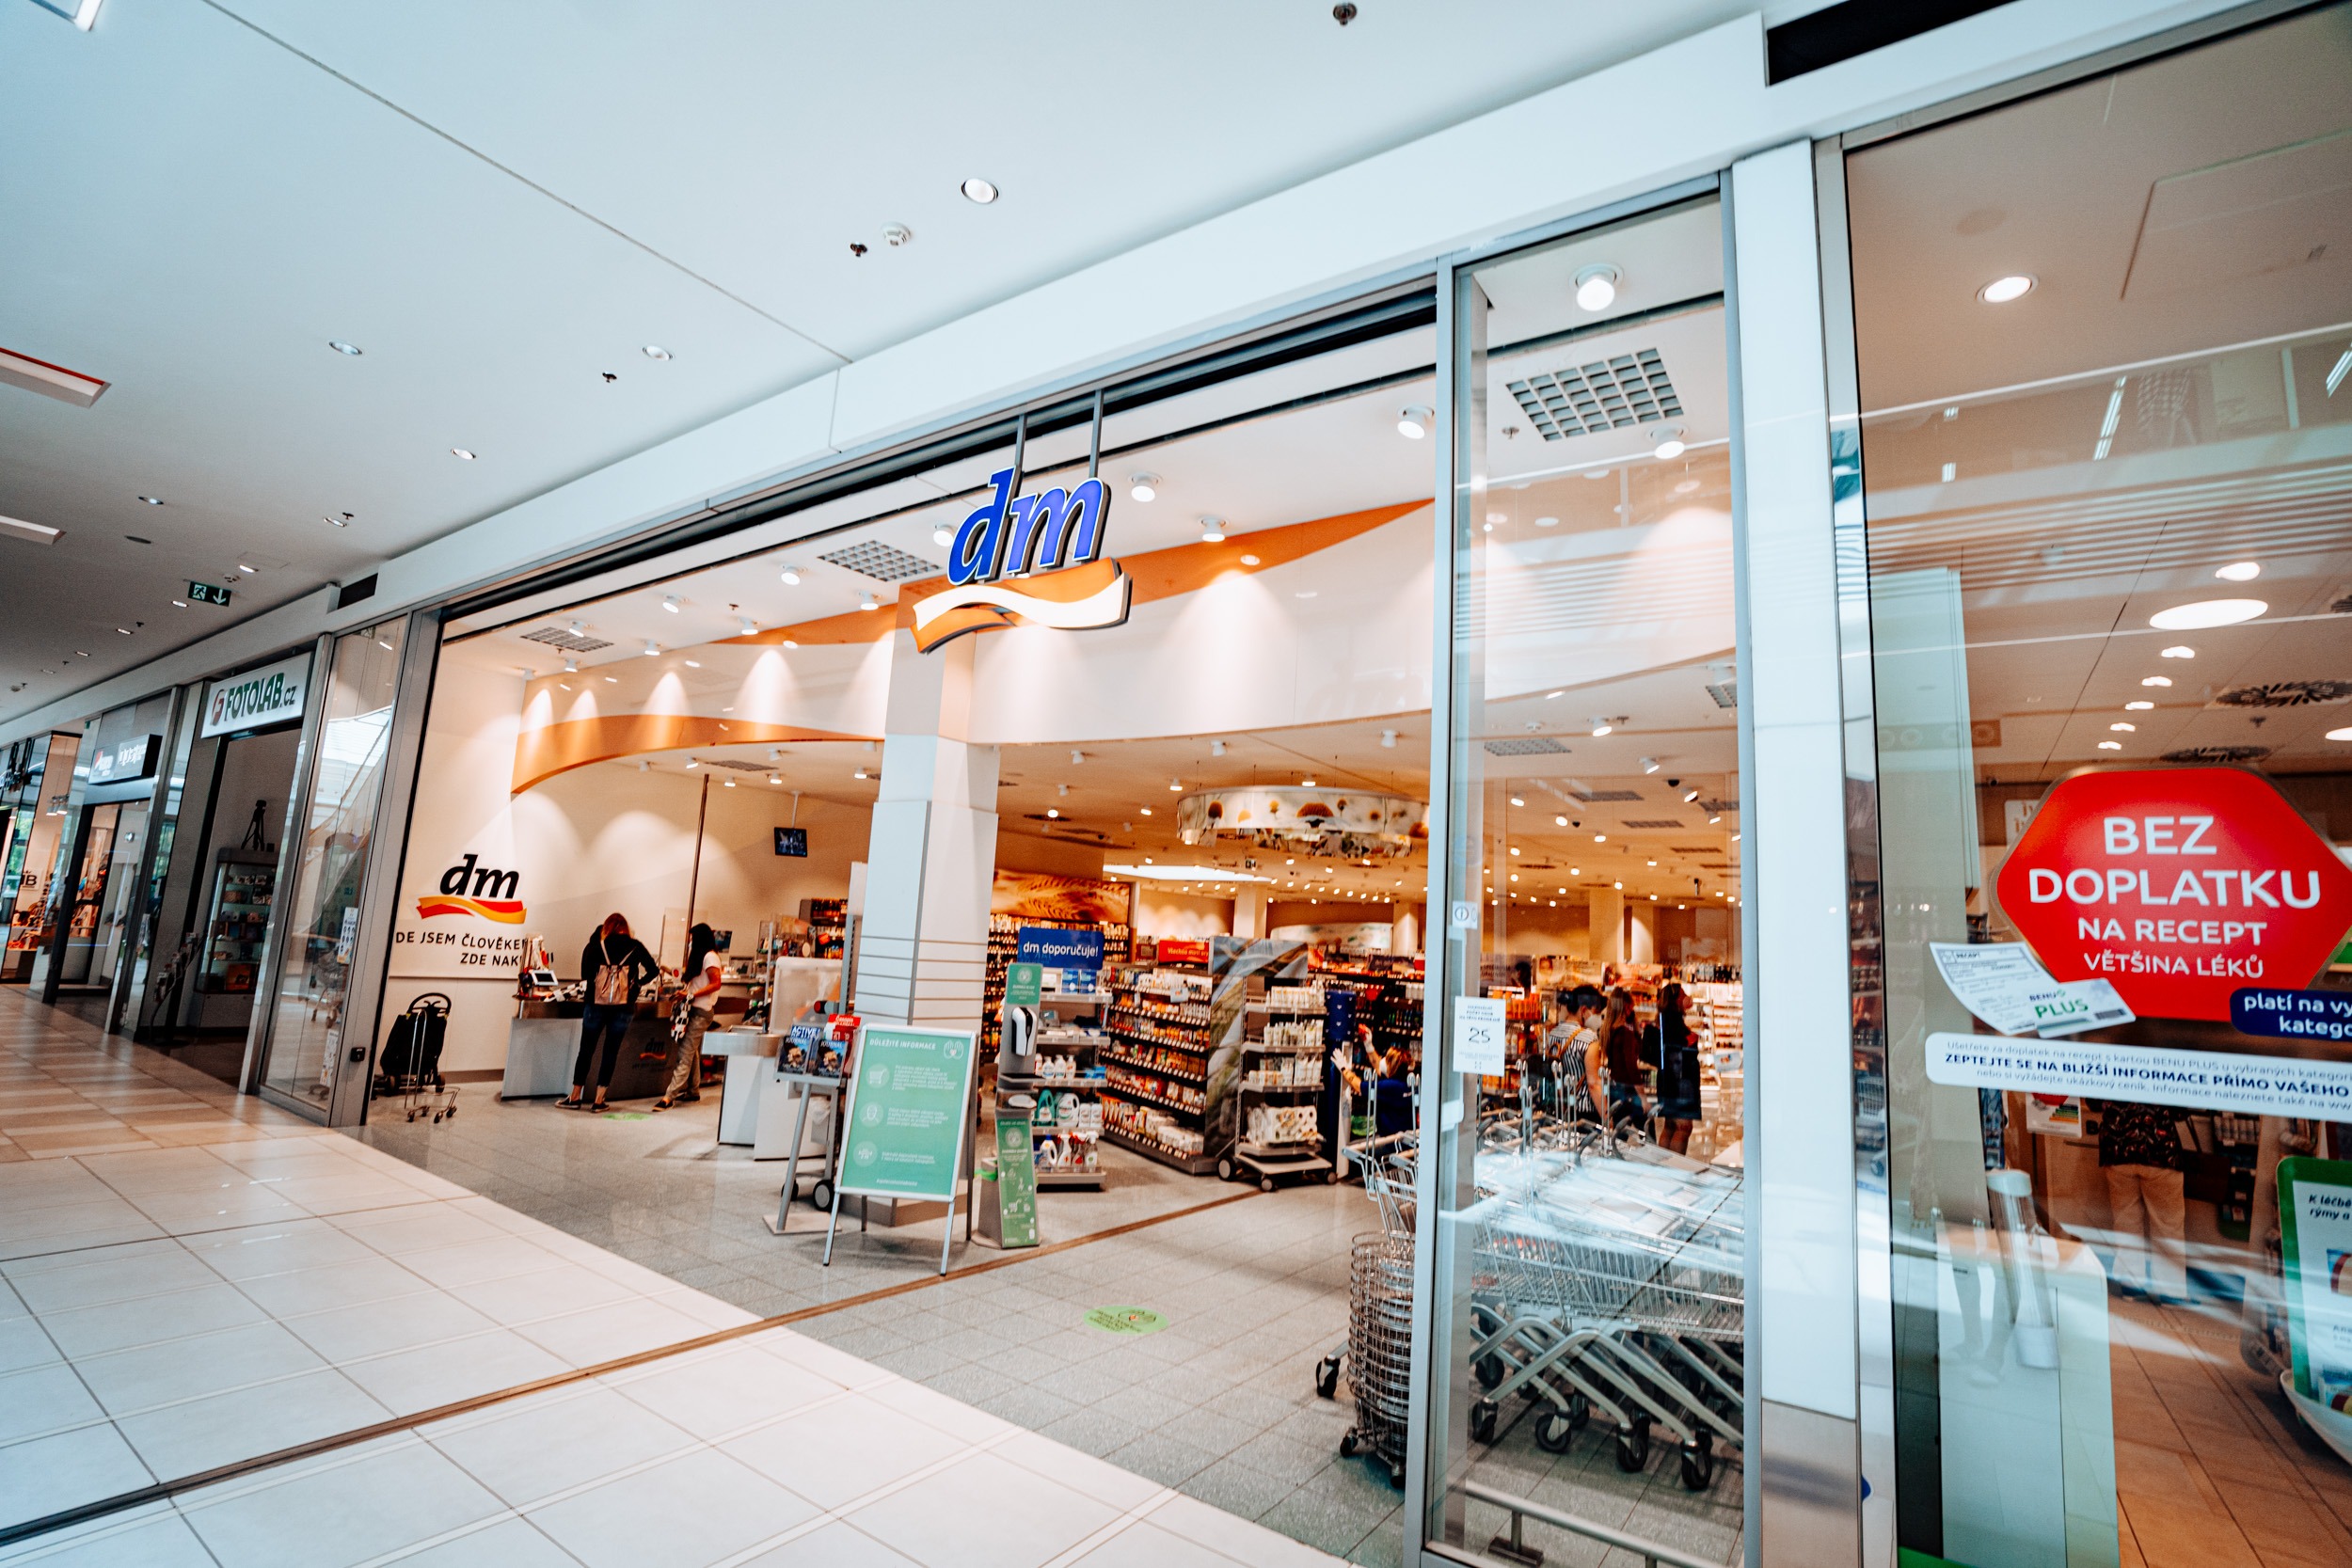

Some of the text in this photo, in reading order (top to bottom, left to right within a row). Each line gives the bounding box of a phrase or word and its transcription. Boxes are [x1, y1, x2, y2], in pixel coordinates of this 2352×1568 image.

[947, 465, 1105, 585] dm
[2103, 816, 2217, 856] BEZ
[439, 853, 519, 899] dm
[2028, 867, 2321, 909] DOPLATKU
[420, 931, 456, 945] JSEM
[2077, 917, 2267, 945] NA RECEPT
[459, 952, 487, 965] ZDE
[1023, 941, 1099, 959] dm doporučuje!
[2083, 949, 2265, 979] VĚTŠINA LÉKŮ
[2034, 998, 2089, 1019] PLUS
[2244, 992, 2293, 1012] platí
[2298, 999, 2324, 1013] na
[869, 1037, 937, 1051] DŮLEŽITÉ INFORMACE
[1469, 1027, 1490, 1043] 25
[2005, 1046, 2049, 1056] doplatek
[2068, 1052, 2101, 1062] recept
[2113, 1053, 2150, 1065] kartou
[2153, 1057, 2185, 1068] BENU
[2188, 1059, 2219, 1070] PLUS
[2233, 1063, 2296, 1077] vybraných
[1945, 1053, 2349, 1098] ZEPTEJTE SE NA BLIŽŠÍ INFORMACE PŘÍMO VAŠEHO
[1977, 1069, 2001, 1078] nebo
[2014, 1071, 2063, 1085] vyžádejte
[2066, 1076, 2115, 1089] ukázkový
[2153, 1084, 2211, 1098] Informace
[2215, 1089, 2274, 1102] naleznete
[2278, 1094, 2306, 1105] také
[2310, 1100, 2325, 1108] na
[2309, 1194, 2352, 1209] K léčbě
[2310, 1207, 2350, 1221] rýmy a
